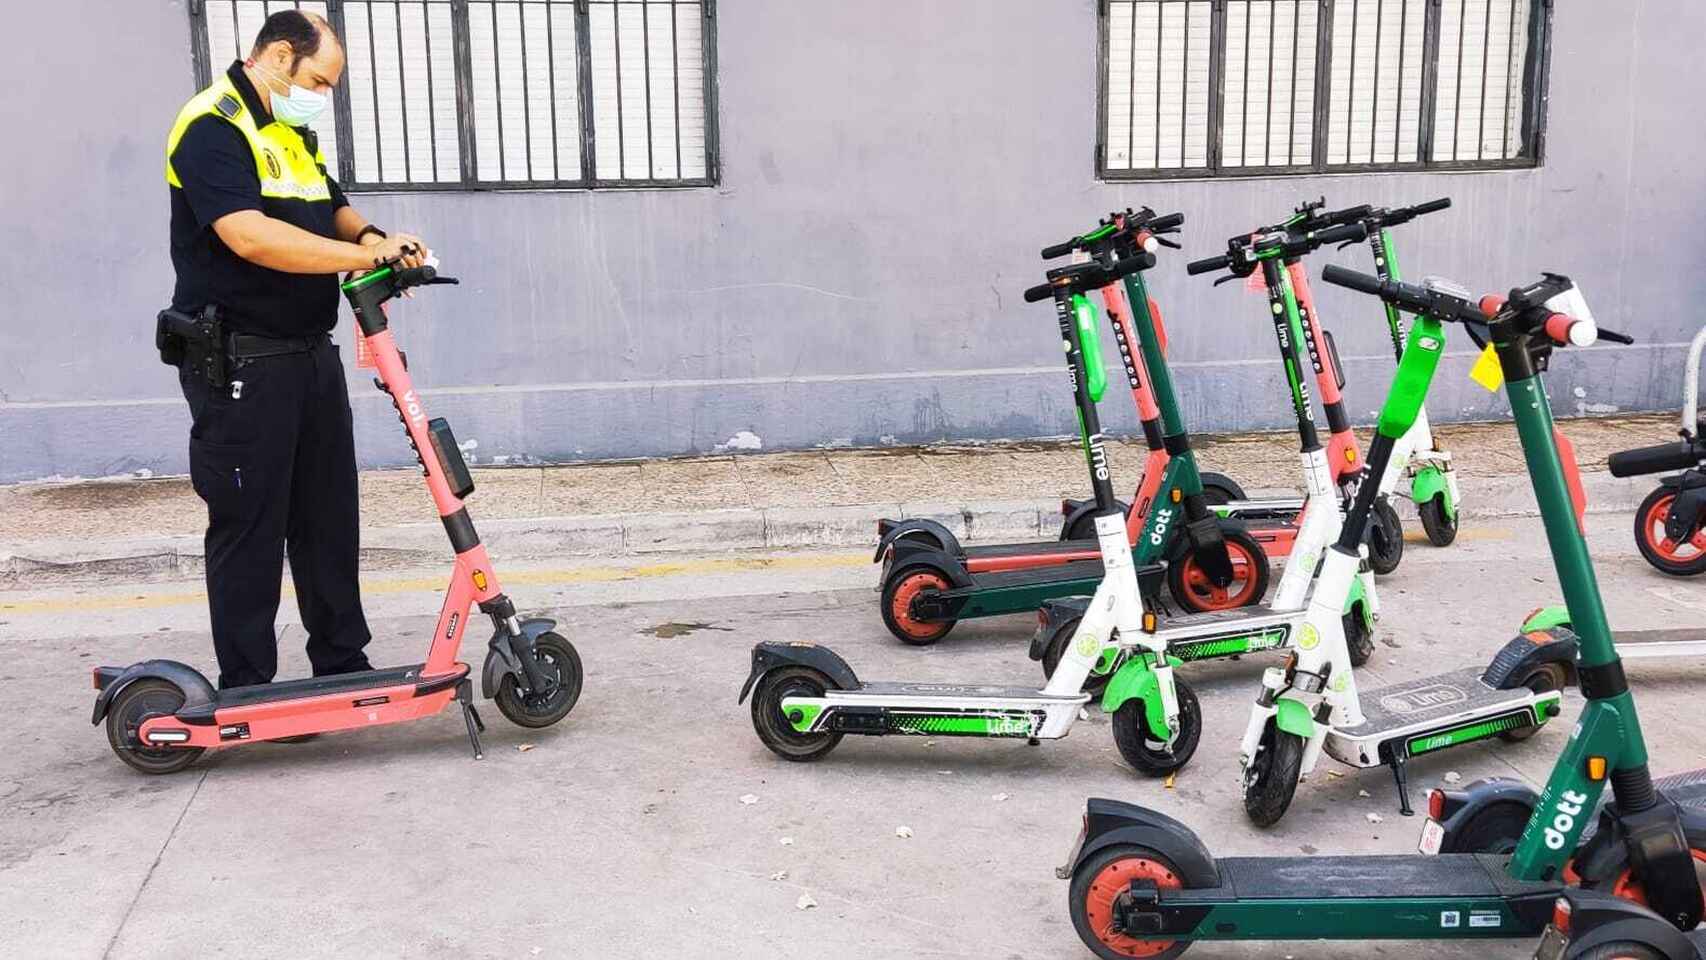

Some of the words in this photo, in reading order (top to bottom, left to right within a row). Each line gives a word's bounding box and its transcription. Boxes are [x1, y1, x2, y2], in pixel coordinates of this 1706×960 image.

[1089, 433, 1109, 480] Lime
[1150, 508, 1173, 545] dott
[1426, 735, 1453, 750] Lime
[1544, 790, 1588, 850] dott
